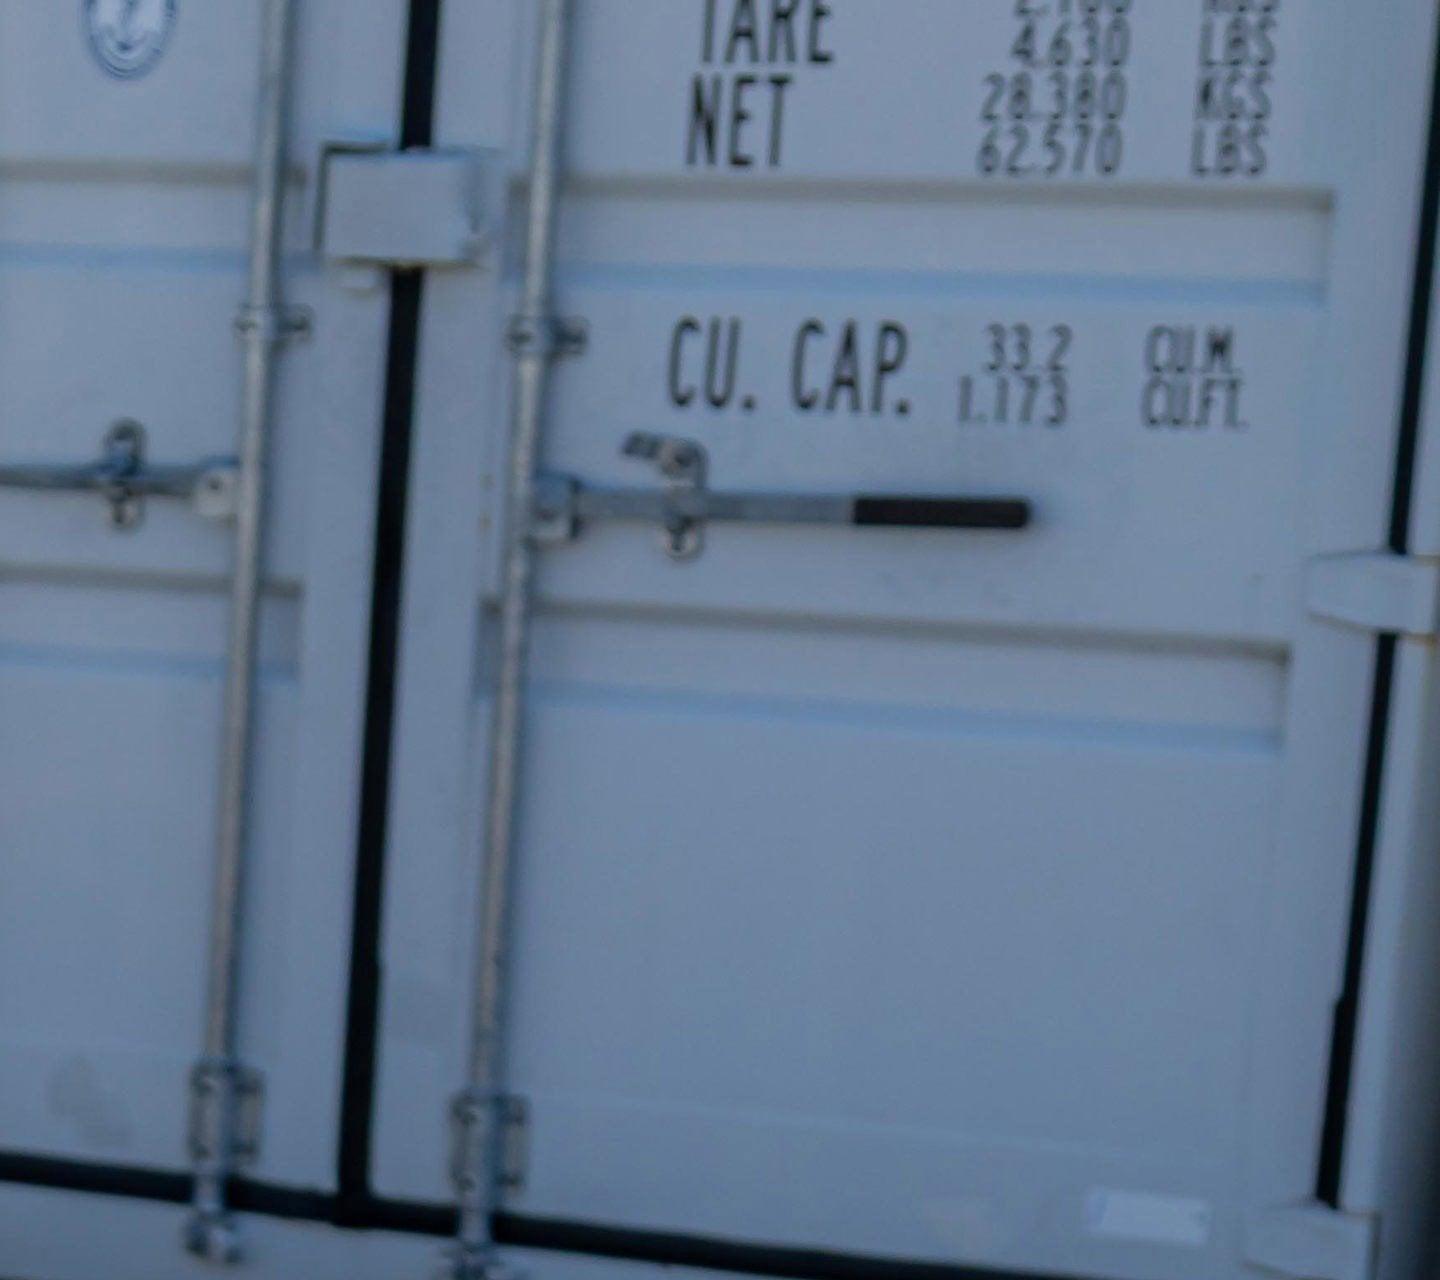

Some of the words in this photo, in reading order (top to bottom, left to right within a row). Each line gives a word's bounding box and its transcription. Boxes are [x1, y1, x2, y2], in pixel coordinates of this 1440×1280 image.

[1010, 17, 1131, 67] 4.630
[1197, 17, 1276, 67] LBS
[686, 74, 793, 167] NET
[979, 71, 1128, 122] 28.380
[1194, 72, 1272, 121] KGS
[976, 122, 1124, 176] 62.570
[1191, 123, 1268, 177] LBS
[669, 316, 756, 411] CU.
[792, 317, 909, 416] CAP.
[985, 323, 1074, 373] 33.2
[958, 374, 1069, 428] 1.173
